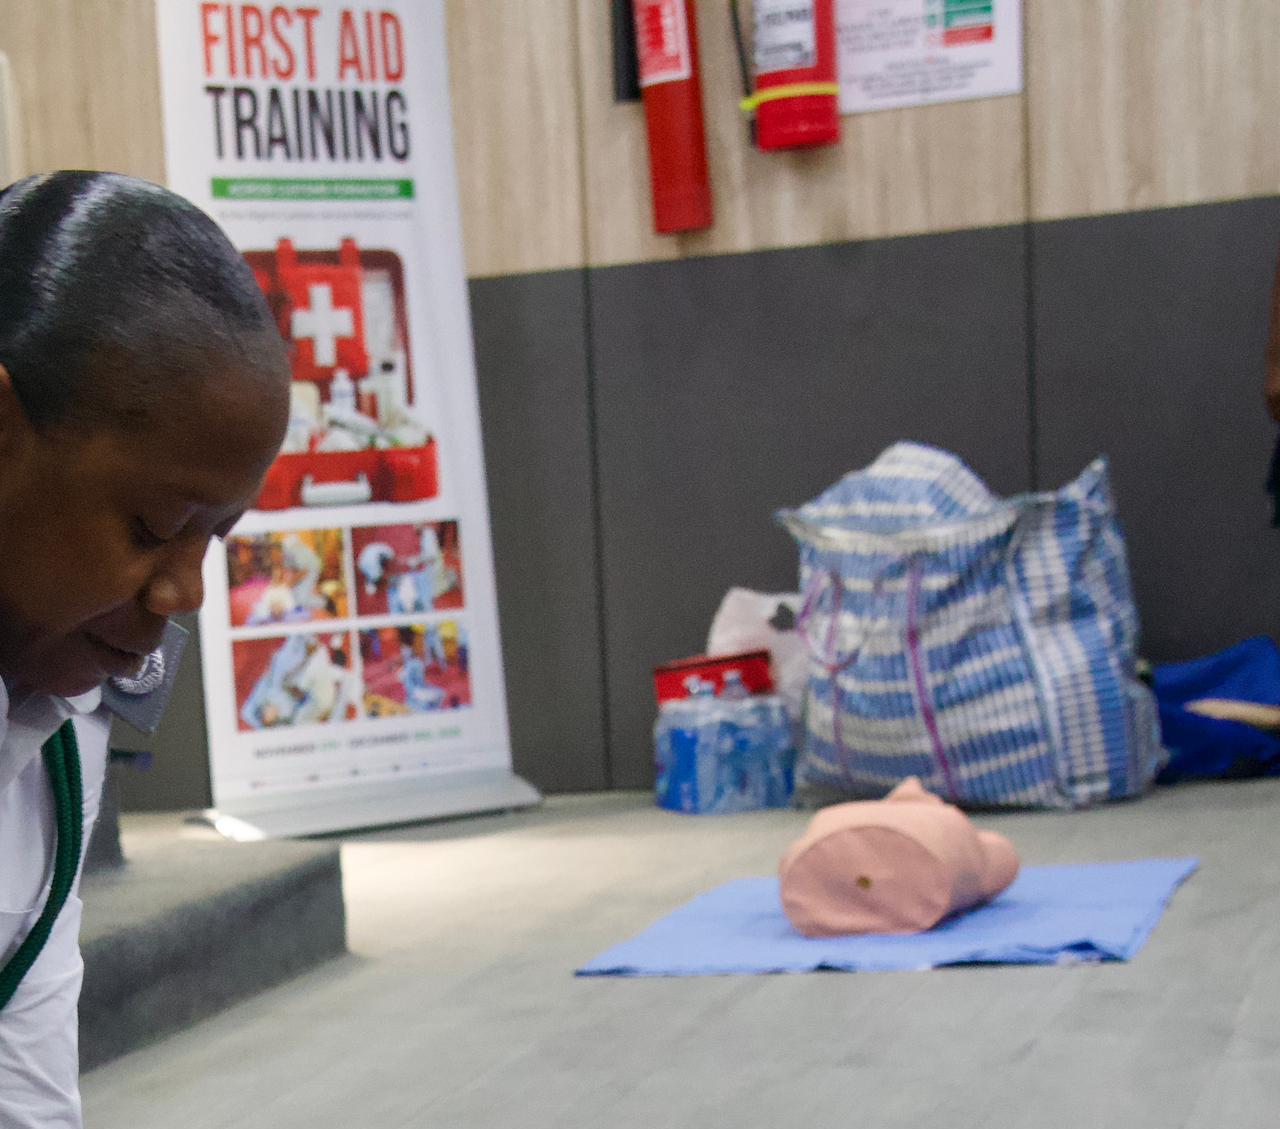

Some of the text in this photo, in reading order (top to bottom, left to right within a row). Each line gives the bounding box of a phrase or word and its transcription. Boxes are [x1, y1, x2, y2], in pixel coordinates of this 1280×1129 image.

[199, 2, 405, 83] FIRST AID
[205, 84, 410, 163] TRAINING
